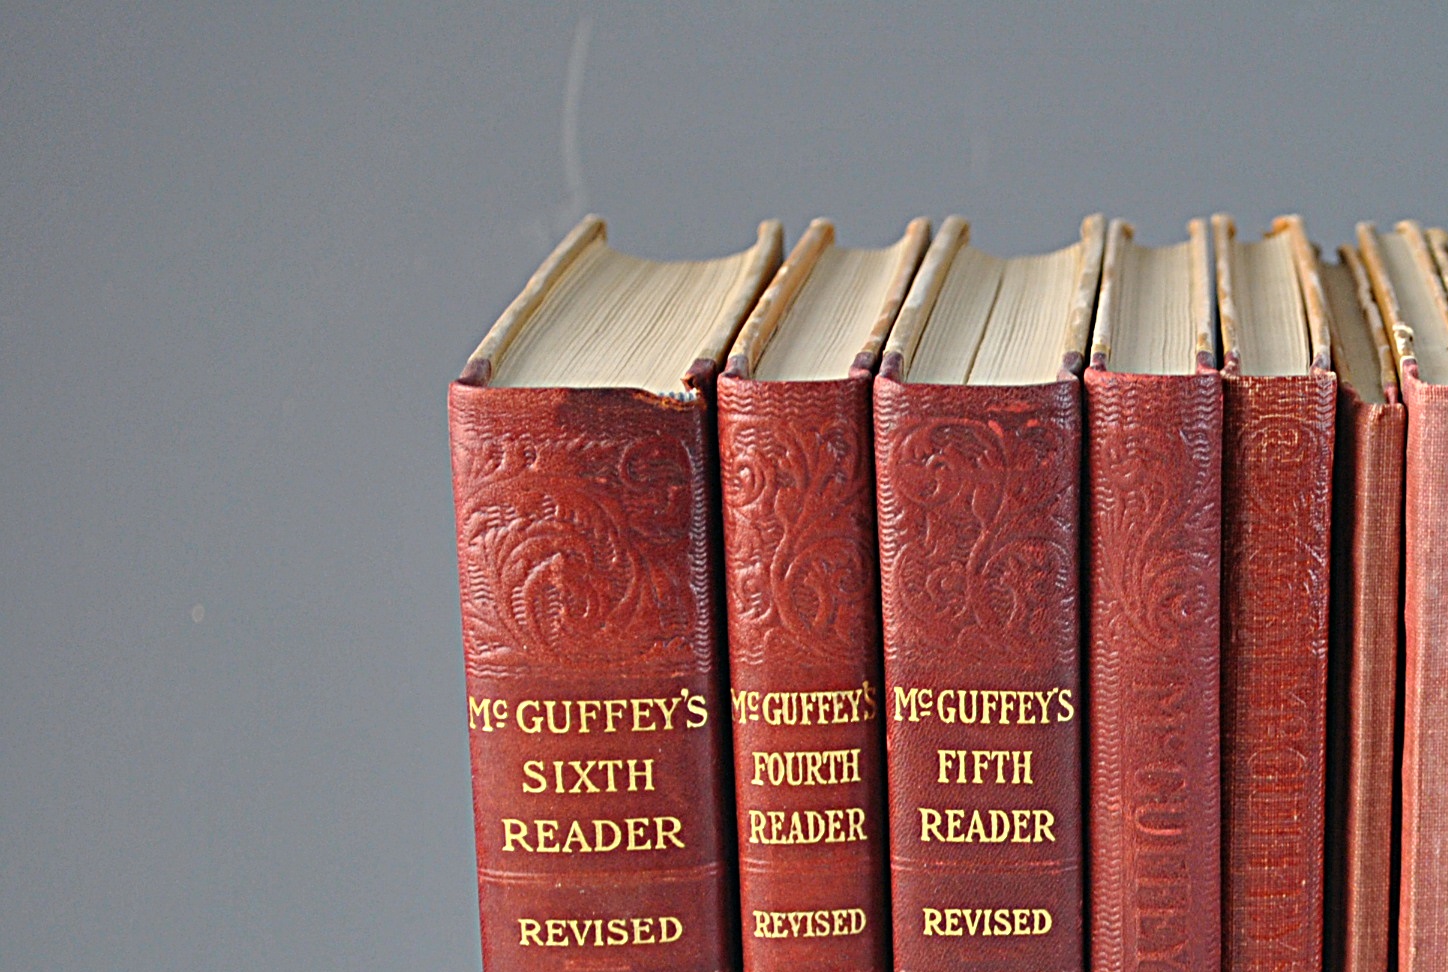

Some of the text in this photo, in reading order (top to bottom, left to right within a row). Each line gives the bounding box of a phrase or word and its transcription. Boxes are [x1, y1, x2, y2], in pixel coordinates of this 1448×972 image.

[523, 759, 654, 793] SIXTH
[751, 749, 861, 786] FOURTH
[938, 750, 1033, 784] FIFTH
[501, 817, 685, 852] READER
[748, 808, 867, 844] READER
[918, 808, 1055, 842] READER
[517, 917, 682, 946] REVISED
[752, 909, 866, 938] REVISED
[923, 908, 1052, 936] REVISED
